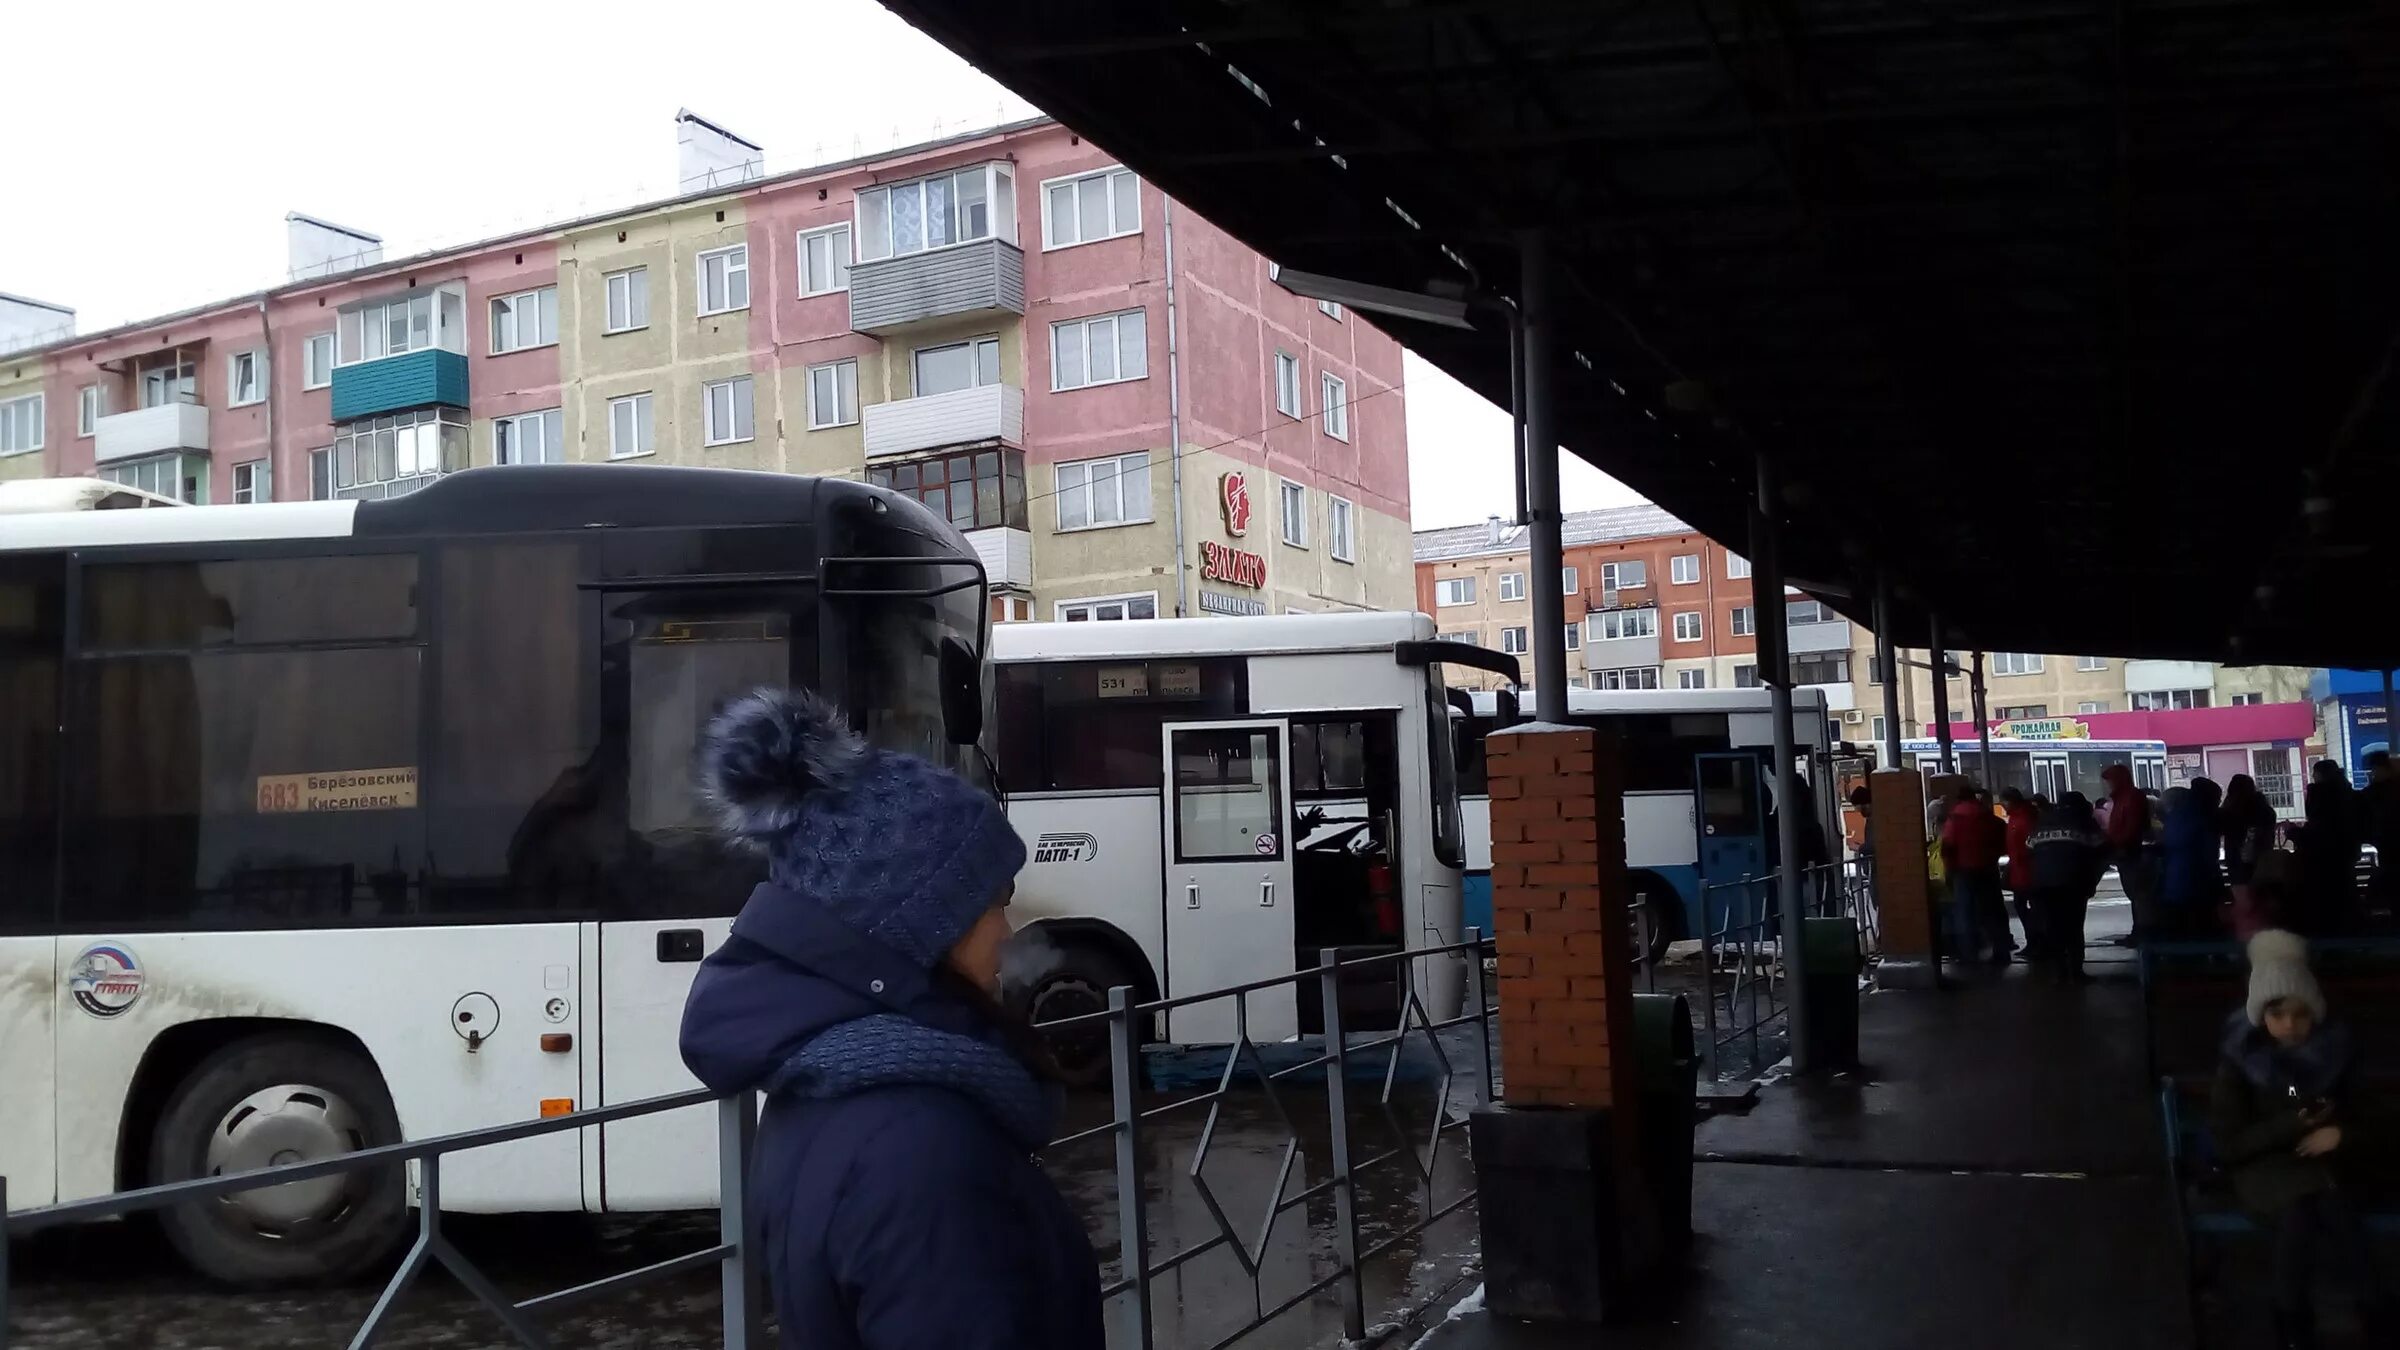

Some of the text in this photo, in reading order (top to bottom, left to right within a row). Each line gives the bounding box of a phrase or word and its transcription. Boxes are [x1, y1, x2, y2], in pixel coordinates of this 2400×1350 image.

[1204, 541, 1267, 588] ЗЛАТО
[1101, 679, 1125, 688] 531
[2010, 722, 2061, 734] УРОЖАЙНАЯ
[260, 783, 299, 810] 683
[1035, 848, 1080, 863] ПАТП-1
